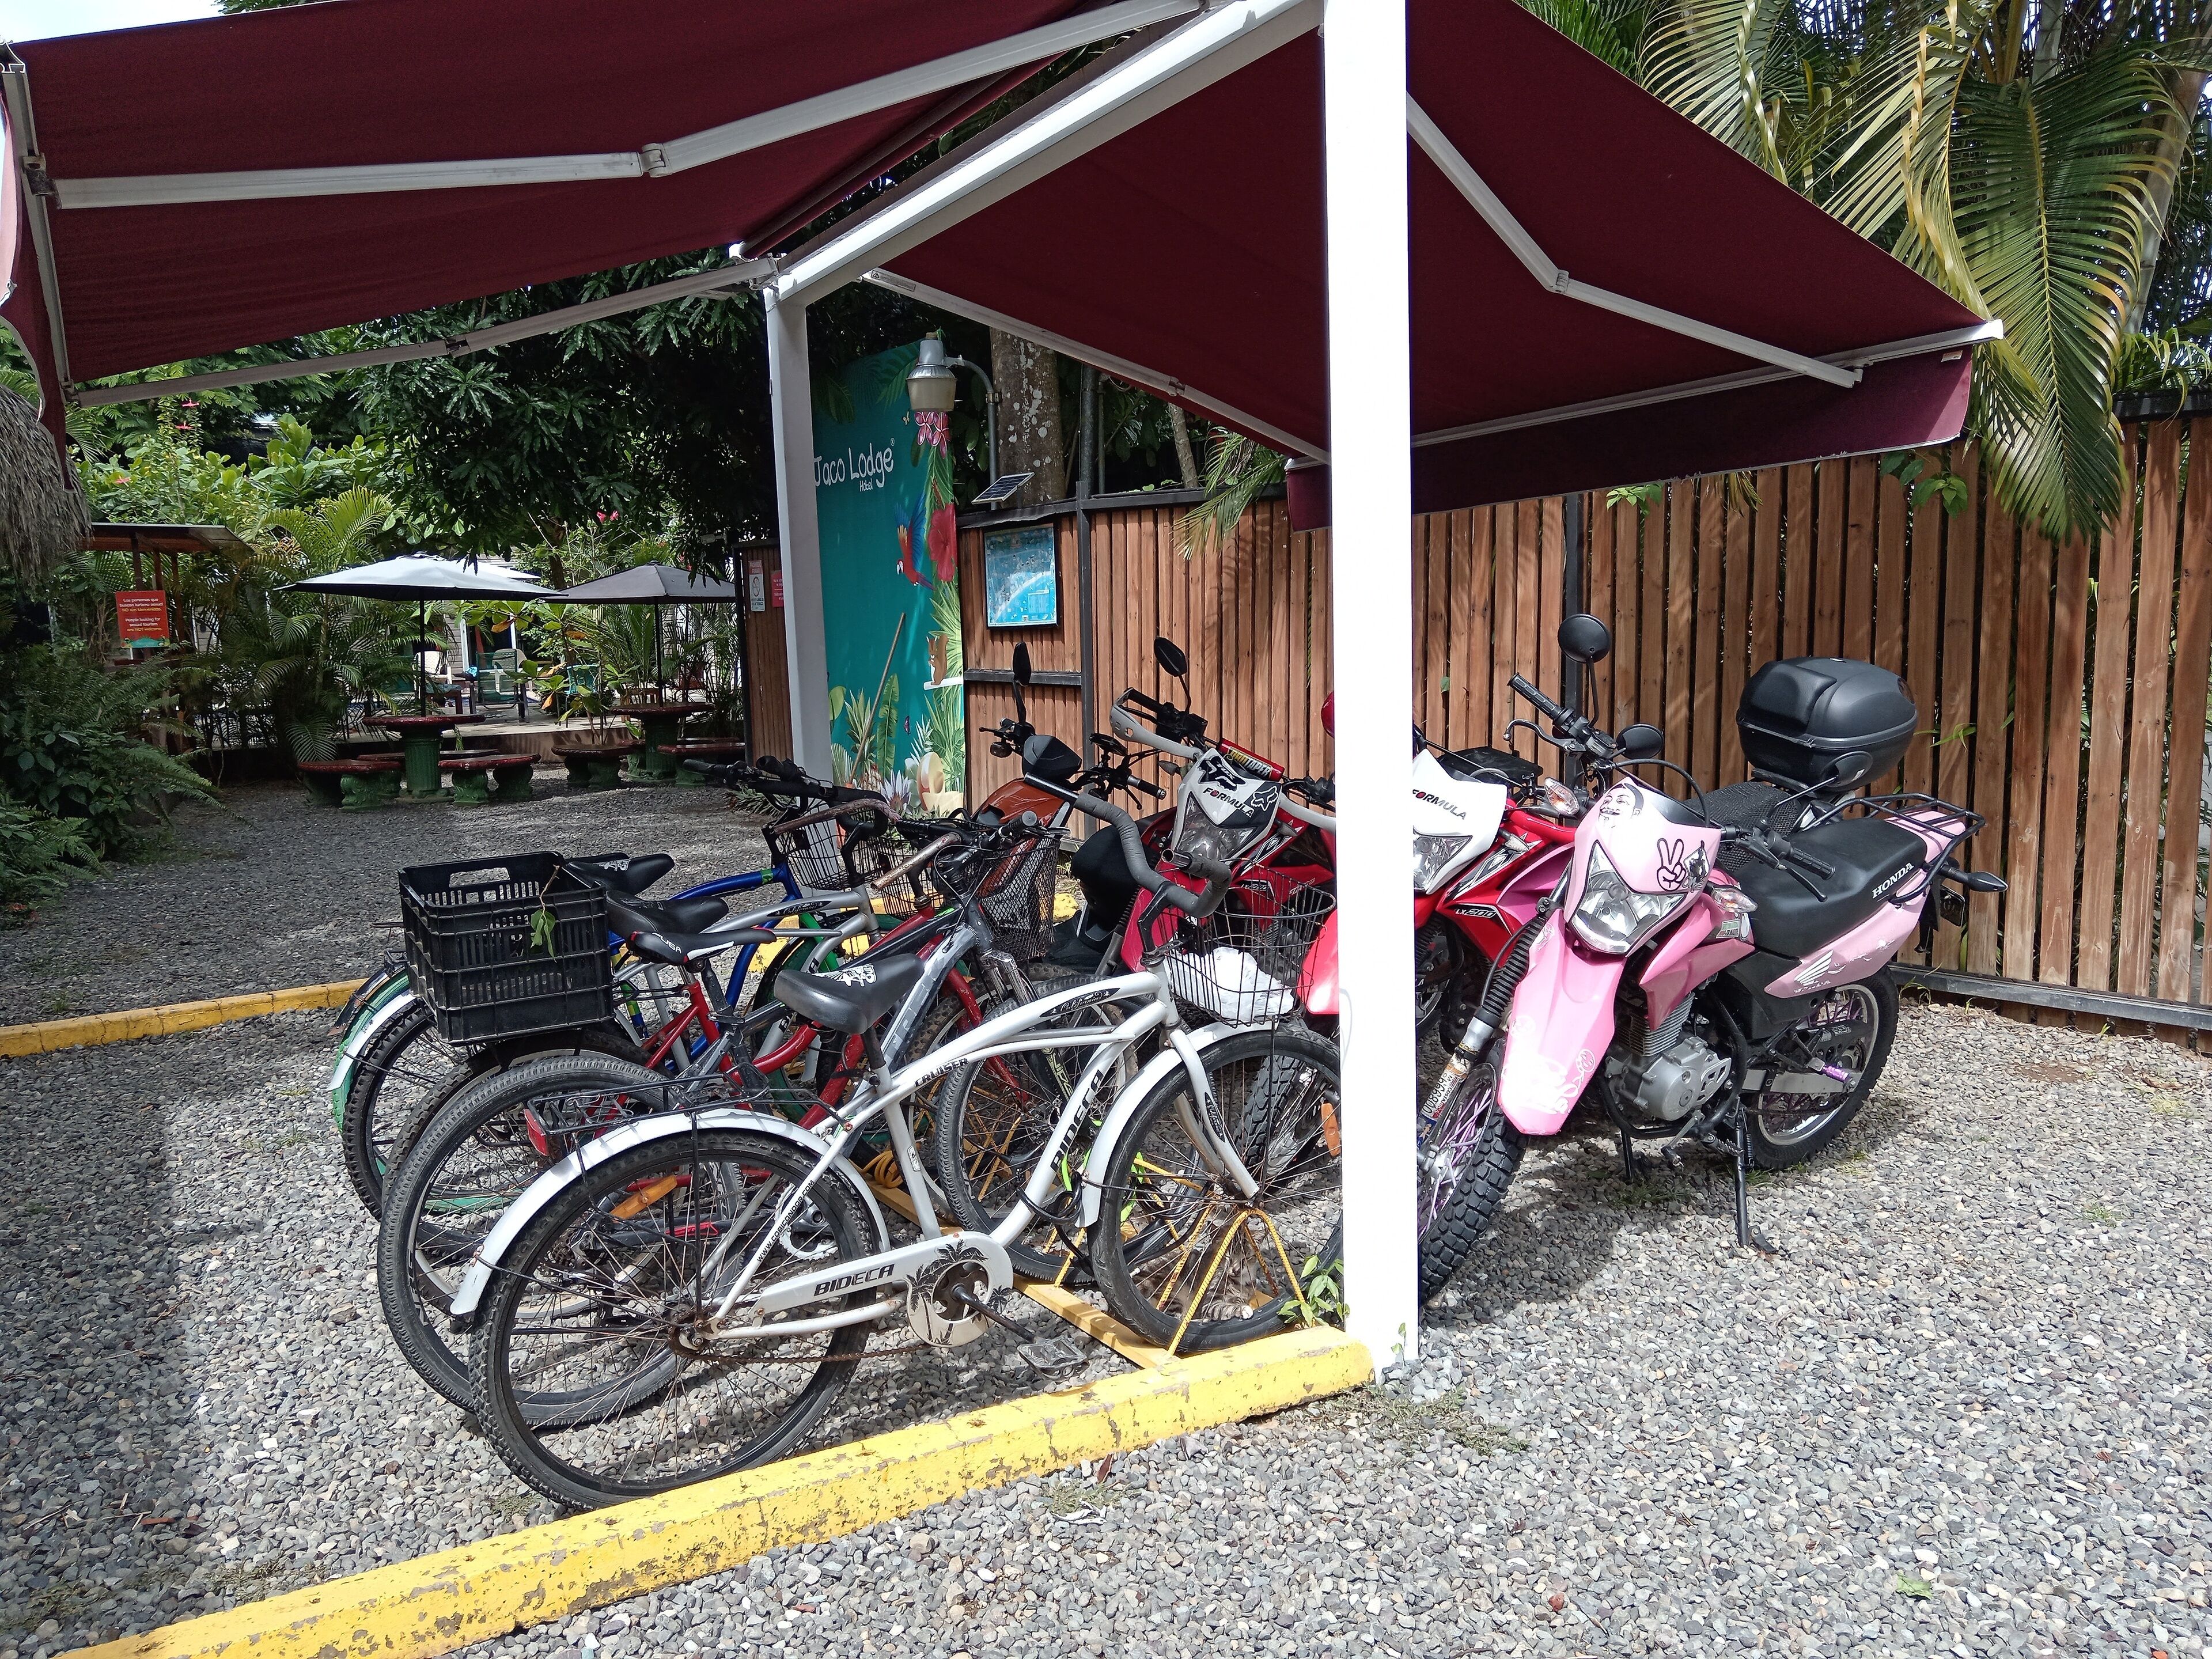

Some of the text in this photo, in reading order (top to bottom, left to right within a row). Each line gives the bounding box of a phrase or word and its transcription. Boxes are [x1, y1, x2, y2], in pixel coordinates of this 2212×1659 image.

[813, 442, 894, 488] Jaco Lodge
[859, 478, 873, 492] Hotel
[1203, 787, 1254, 818] FORMULA
[1412, 789, 1467, 820] FORMULA
[1872, 862, 1914, 899] HONDA
[783, 902, 817, 914] California
[1060, 991, 1103, 1012] California
[915, 1058, 969, 1087] CRUISER
[1441, 1087, 1452, 1101] COSTA
[1050, 1069, 1104, 1171] BIDECA
[756, 1180, 815, 1263] WWW.COBICONDOR.COM
[813, 1264, 895, 1297] BIDECA
